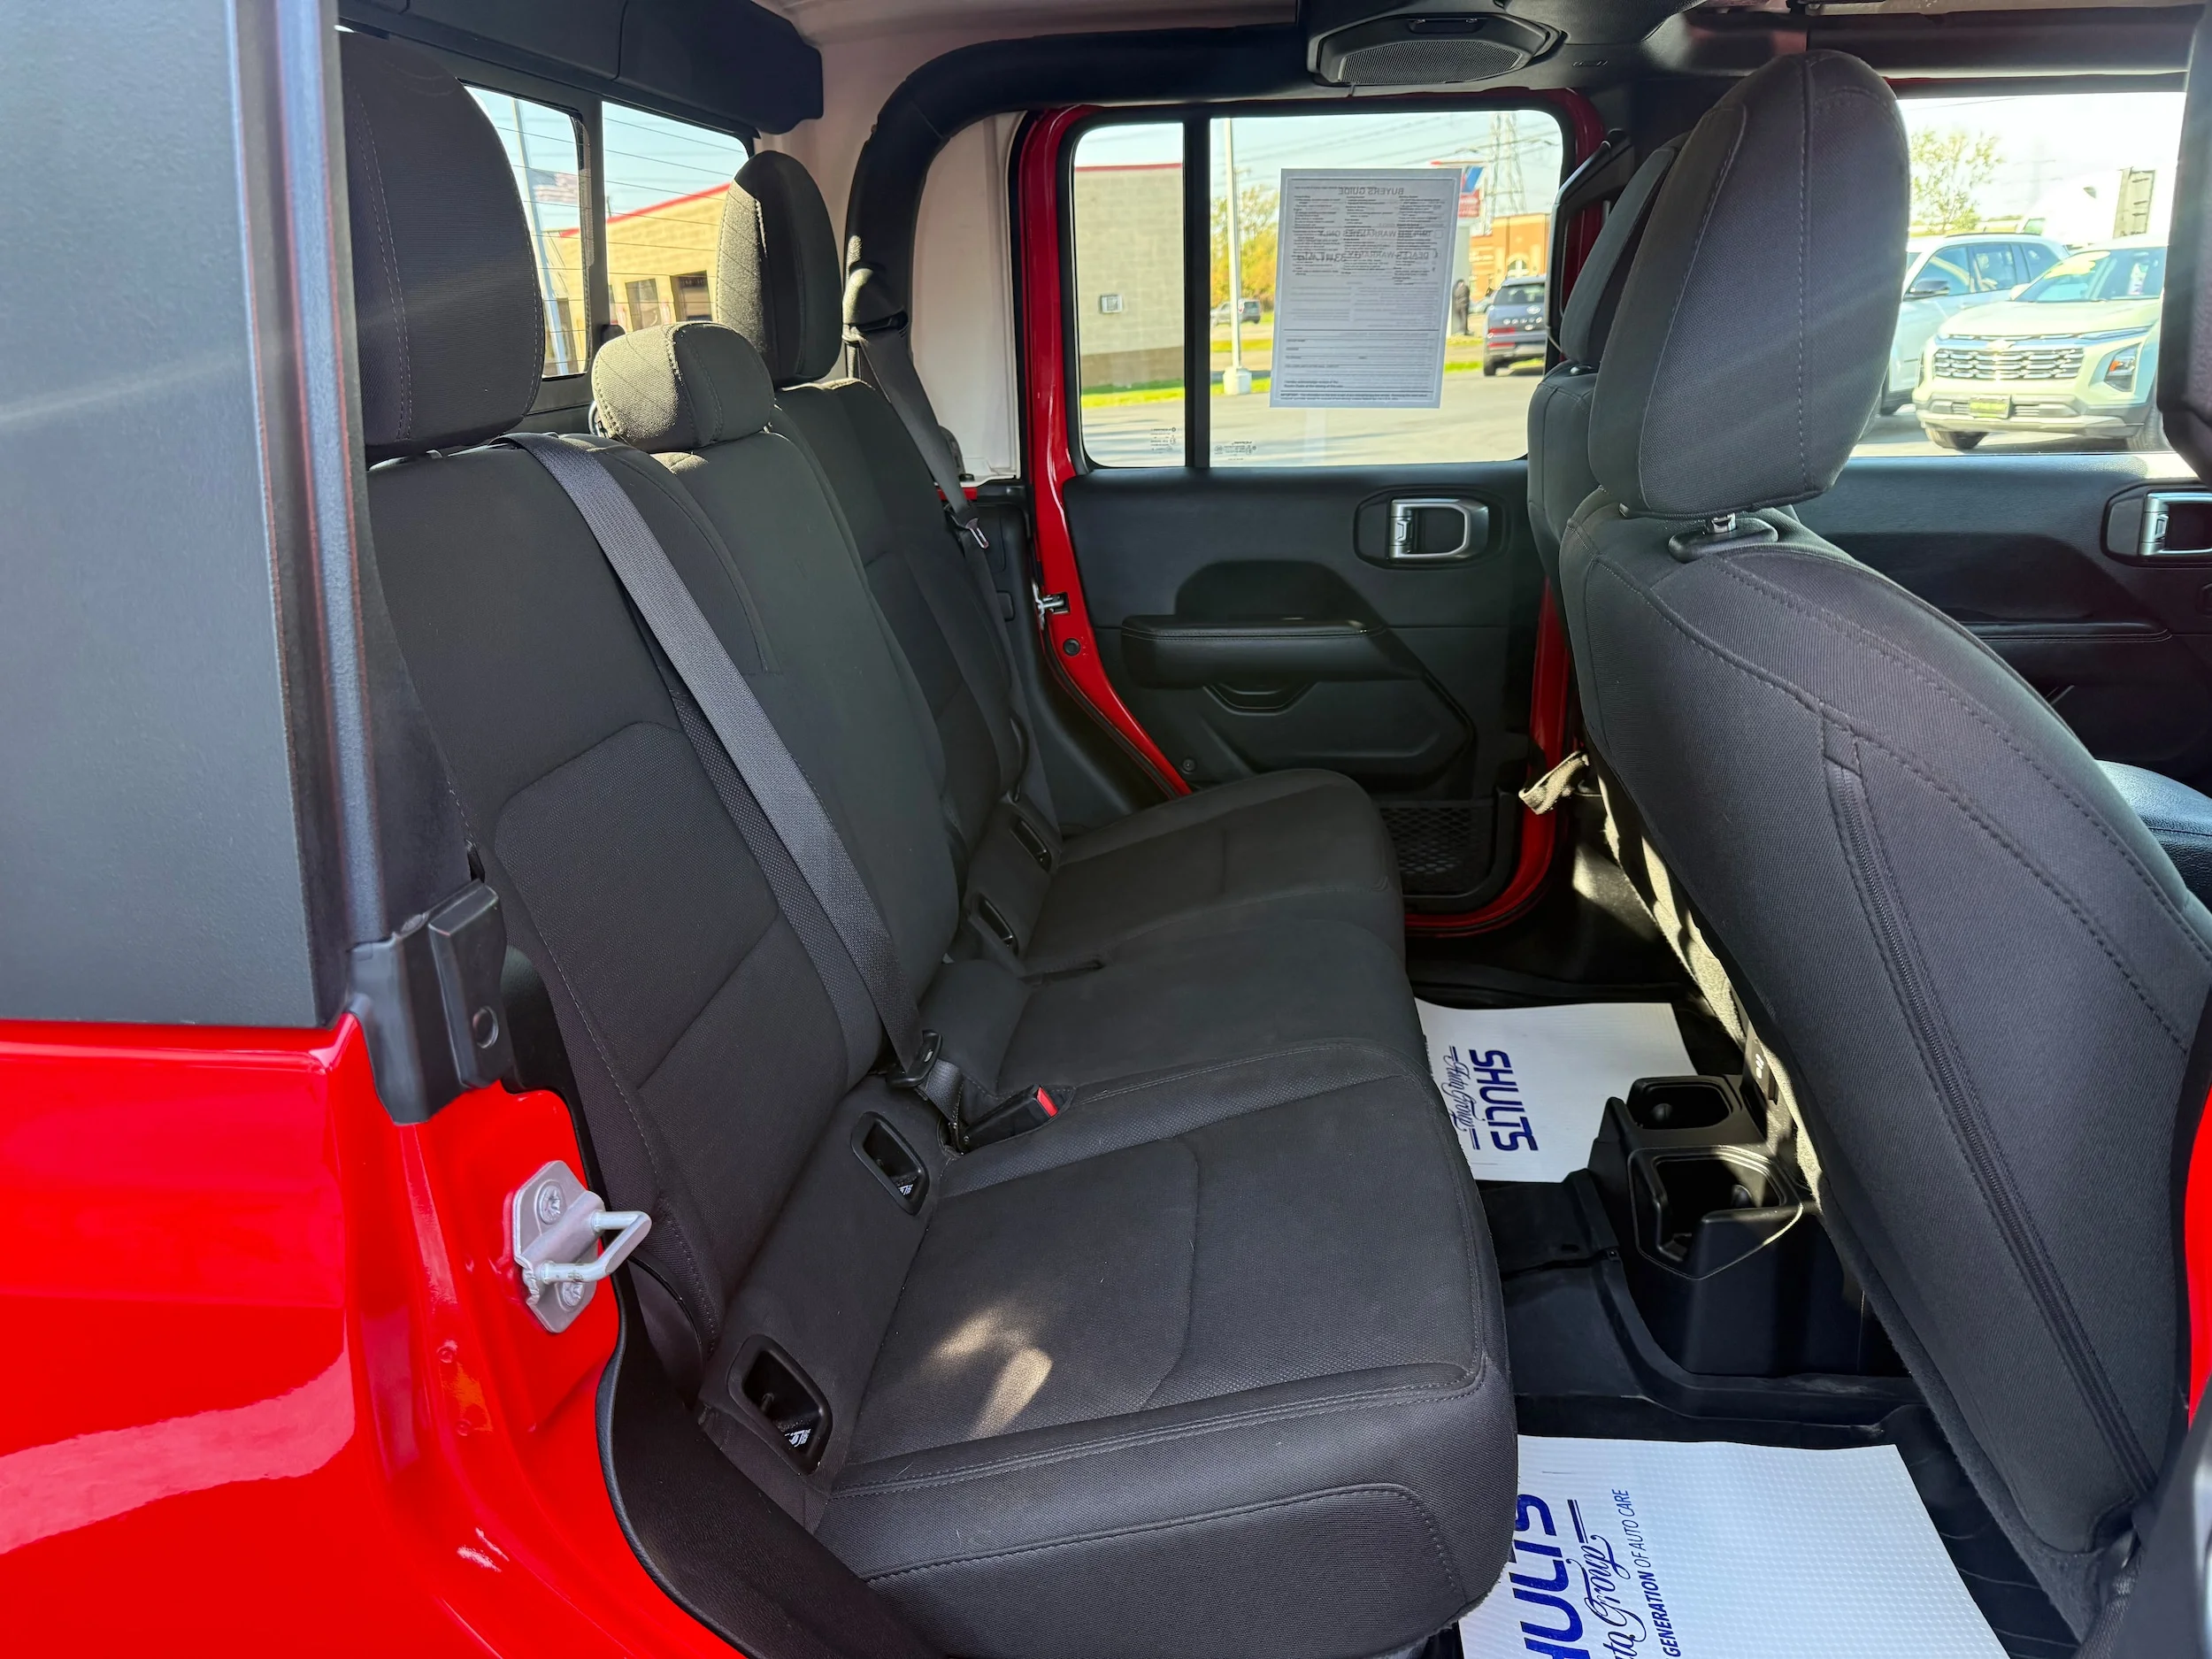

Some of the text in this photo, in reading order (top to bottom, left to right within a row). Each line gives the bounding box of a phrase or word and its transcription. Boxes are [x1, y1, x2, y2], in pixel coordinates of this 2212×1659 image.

[1441, 1055, 1486, 1133] Auto Group
[1468, 1048, 1539, 1151] SHULTS
[1565, 1535, 1647, 1643] Group
[1611, 1488, 1681, 1657] GENERATION OF AUTO CARE
